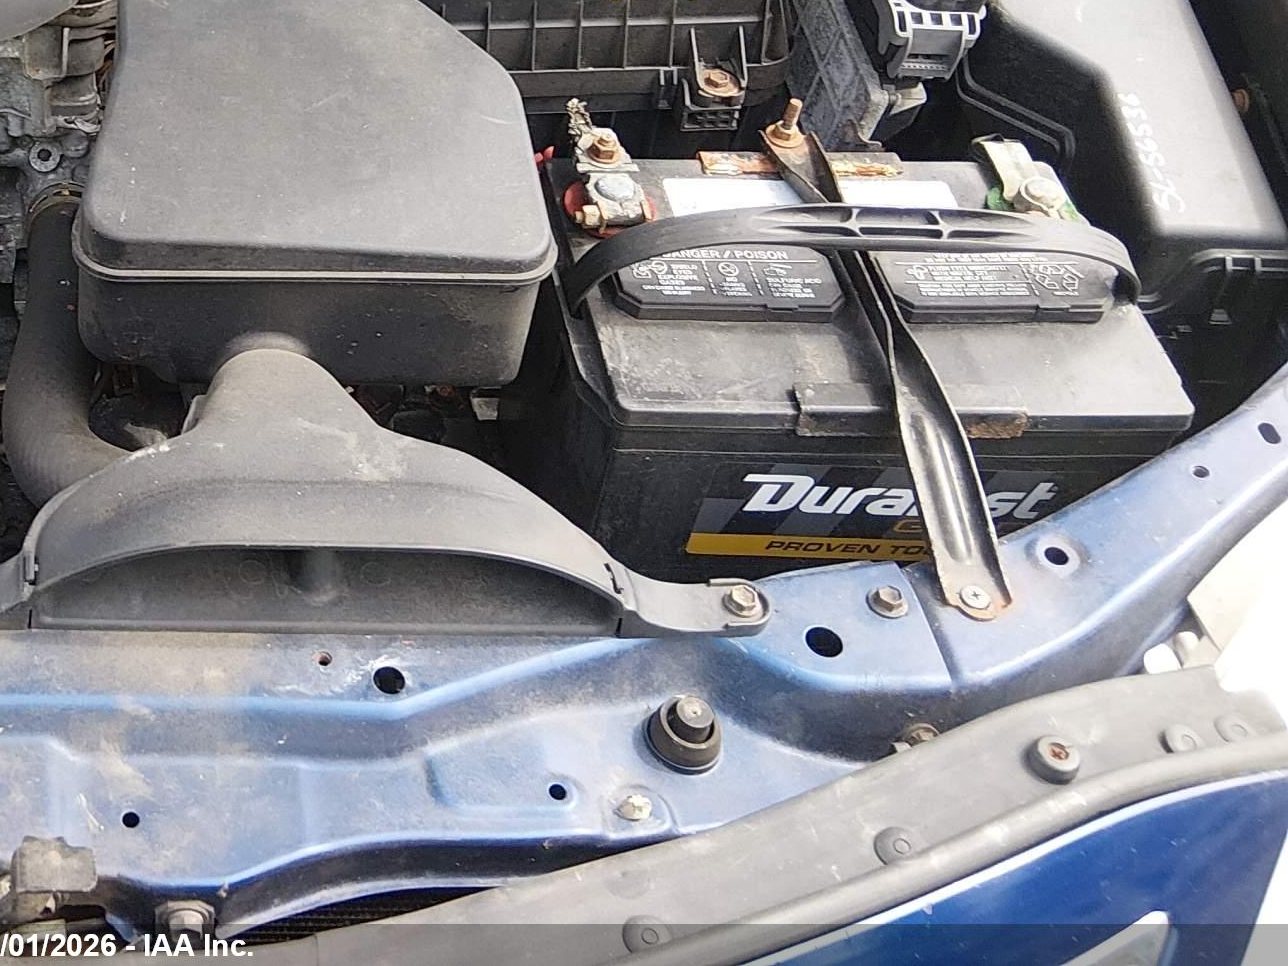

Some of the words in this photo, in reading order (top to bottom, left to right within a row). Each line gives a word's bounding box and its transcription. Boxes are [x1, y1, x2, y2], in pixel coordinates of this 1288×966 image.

[734, 250, 789, 260] POISON
[742, 473, 1060, 519] Durast
[765, 540, 880, 554] PROVEN
